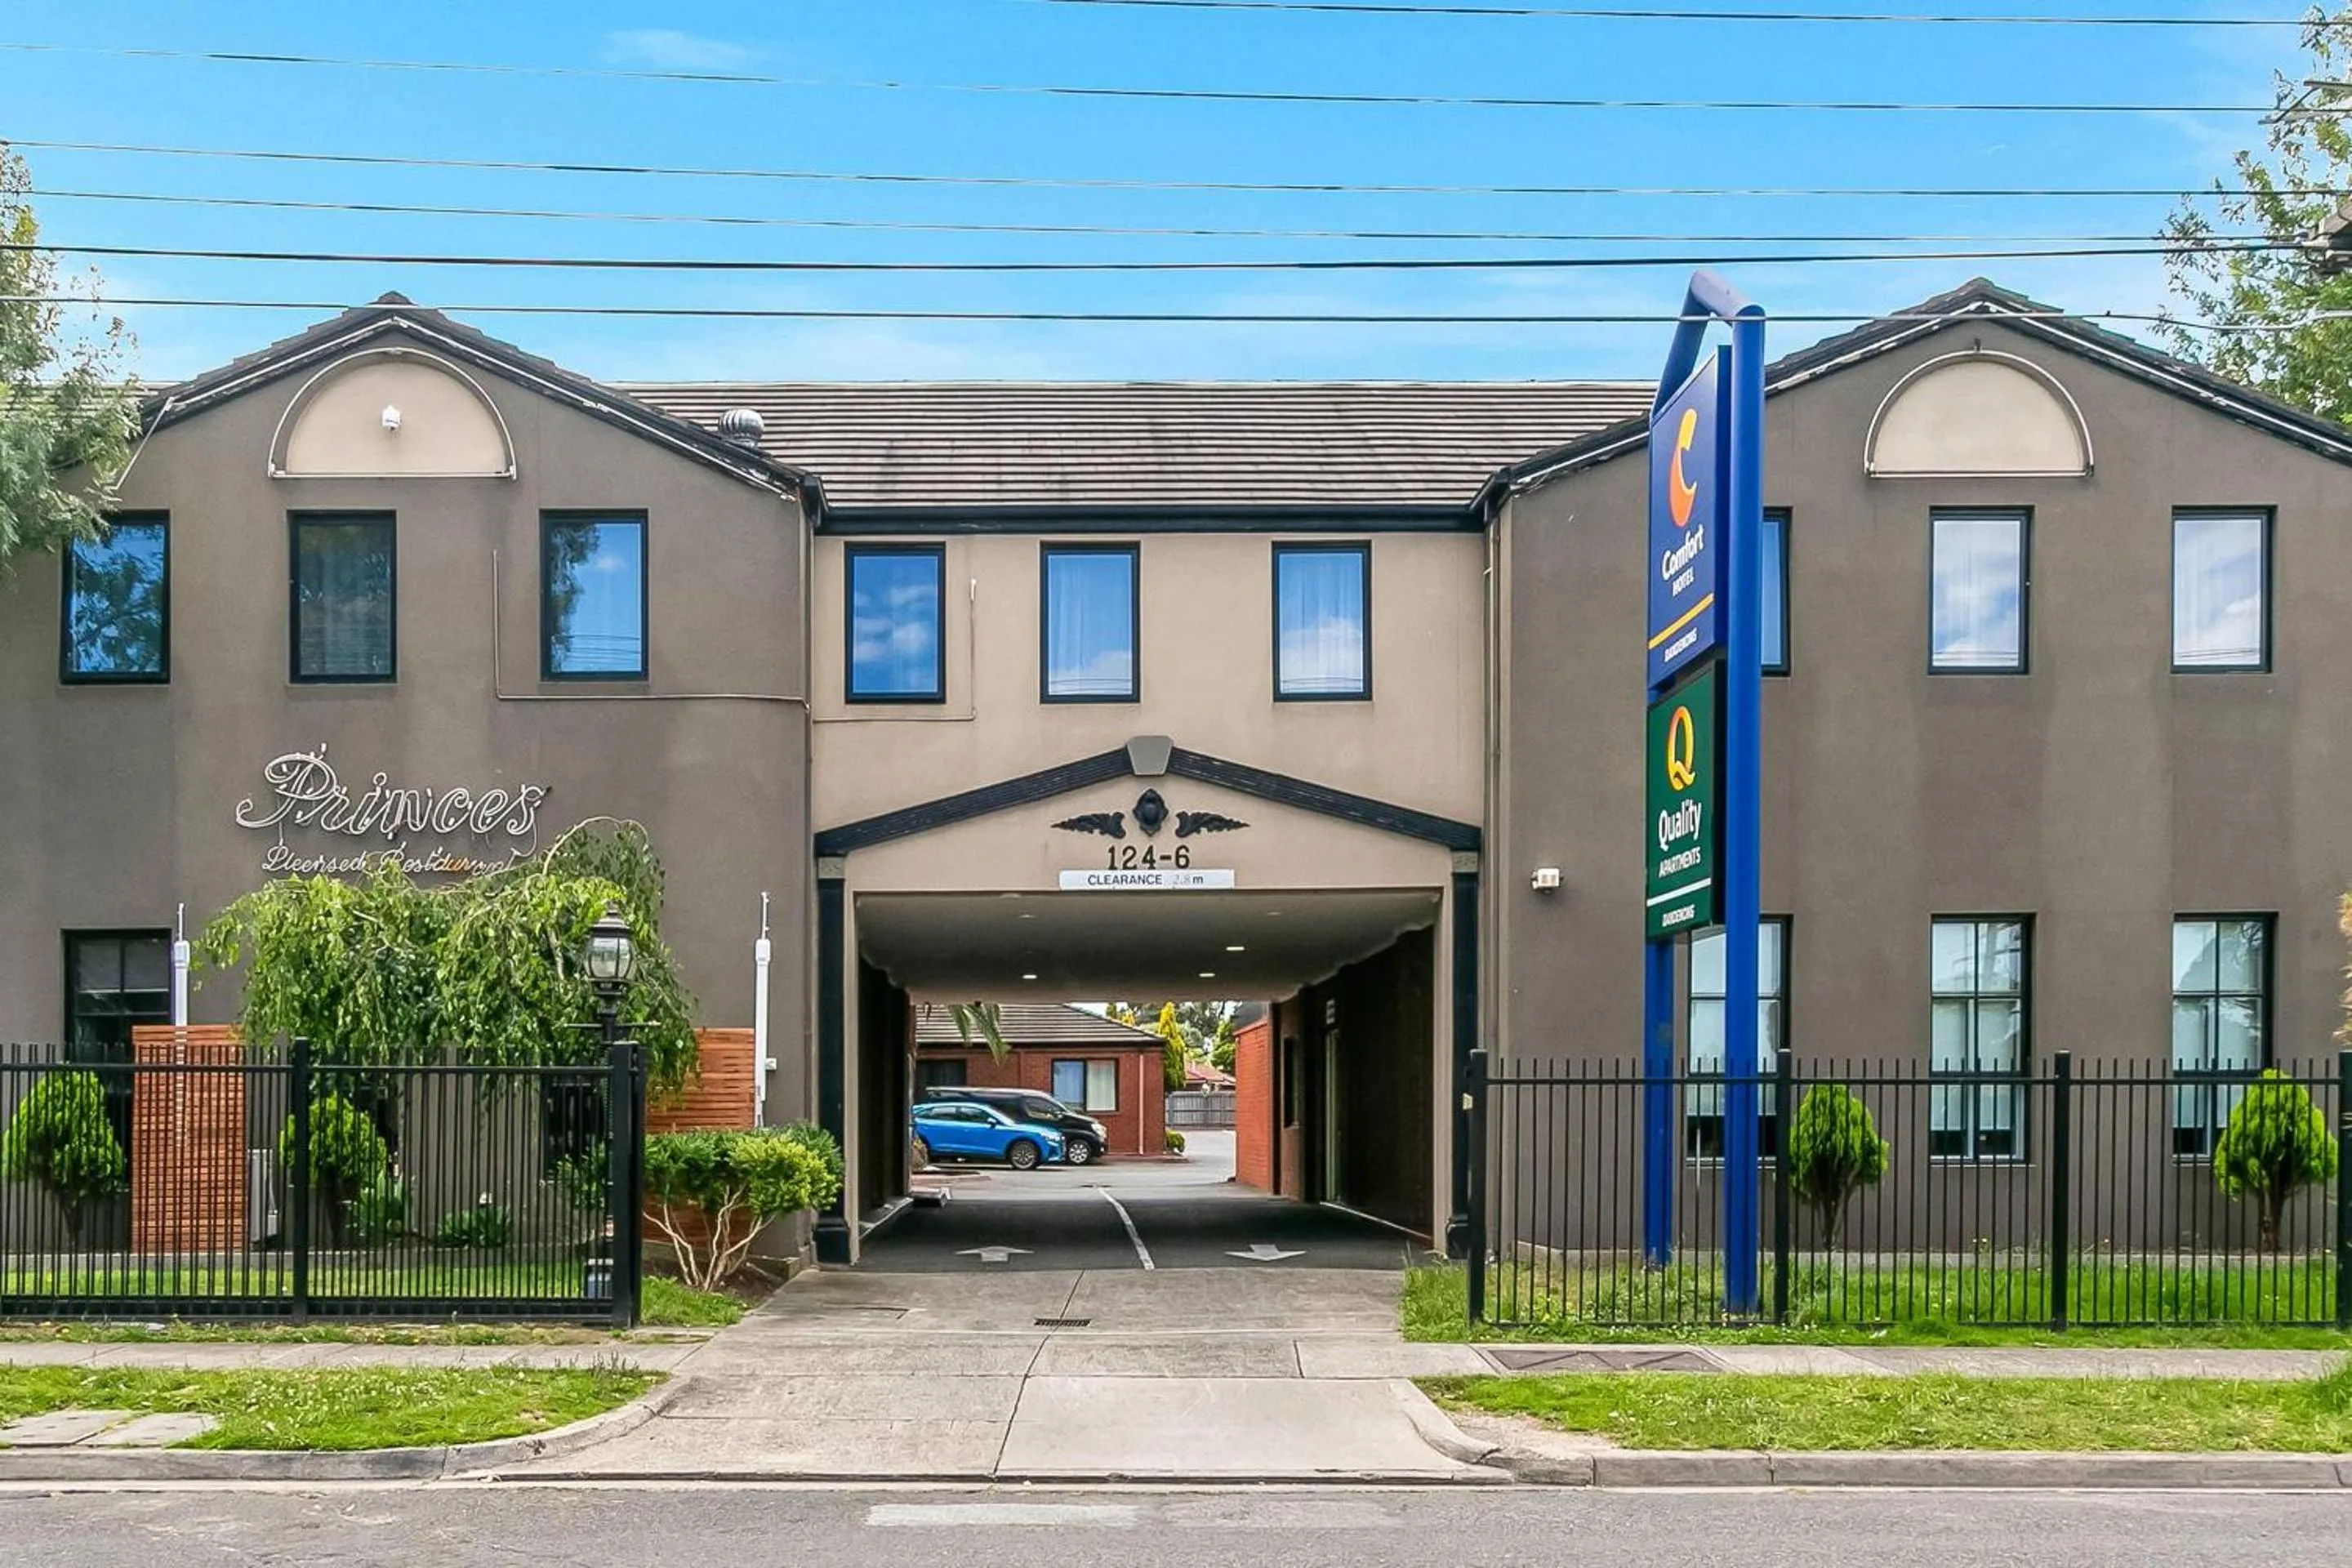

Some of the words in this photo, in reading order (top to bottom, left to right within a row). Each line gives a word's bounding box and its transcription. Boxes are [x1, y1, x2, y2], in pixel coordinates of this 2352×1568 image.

[1661, 523, 1704, 581] Comfort
[1658, 798, 1703, 852] Quality
[1107, 844, 1191, 871] 124-6
[1659, 846, 1702, 879] APARTMENTS
[1087, 874, 1162, 886] CLEARANCE
[1192, 875, 1204, 884] m
